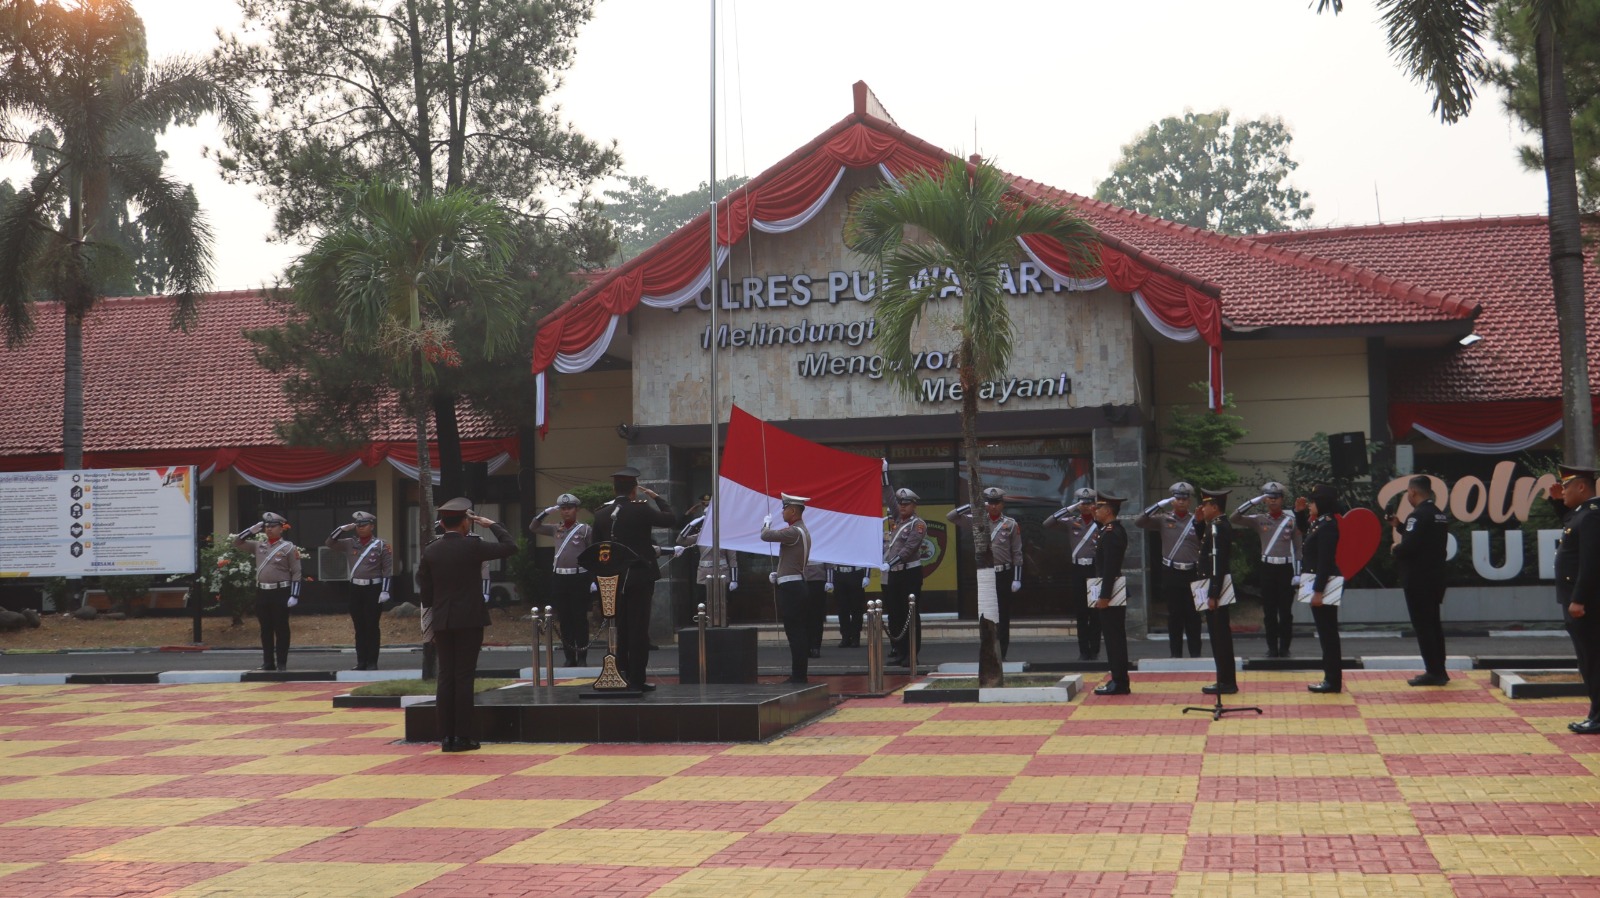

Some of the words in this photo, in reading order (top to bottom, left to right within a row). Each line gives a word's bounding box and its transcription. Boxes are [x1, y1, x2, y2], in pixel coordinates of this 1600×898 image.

[672, 274, 813, 313] OLRES
[701, 317, 876, 349] Melindungi
[918, 372, 1066, 404] Meayani
[1377, 461, 1600, 544] Polr
